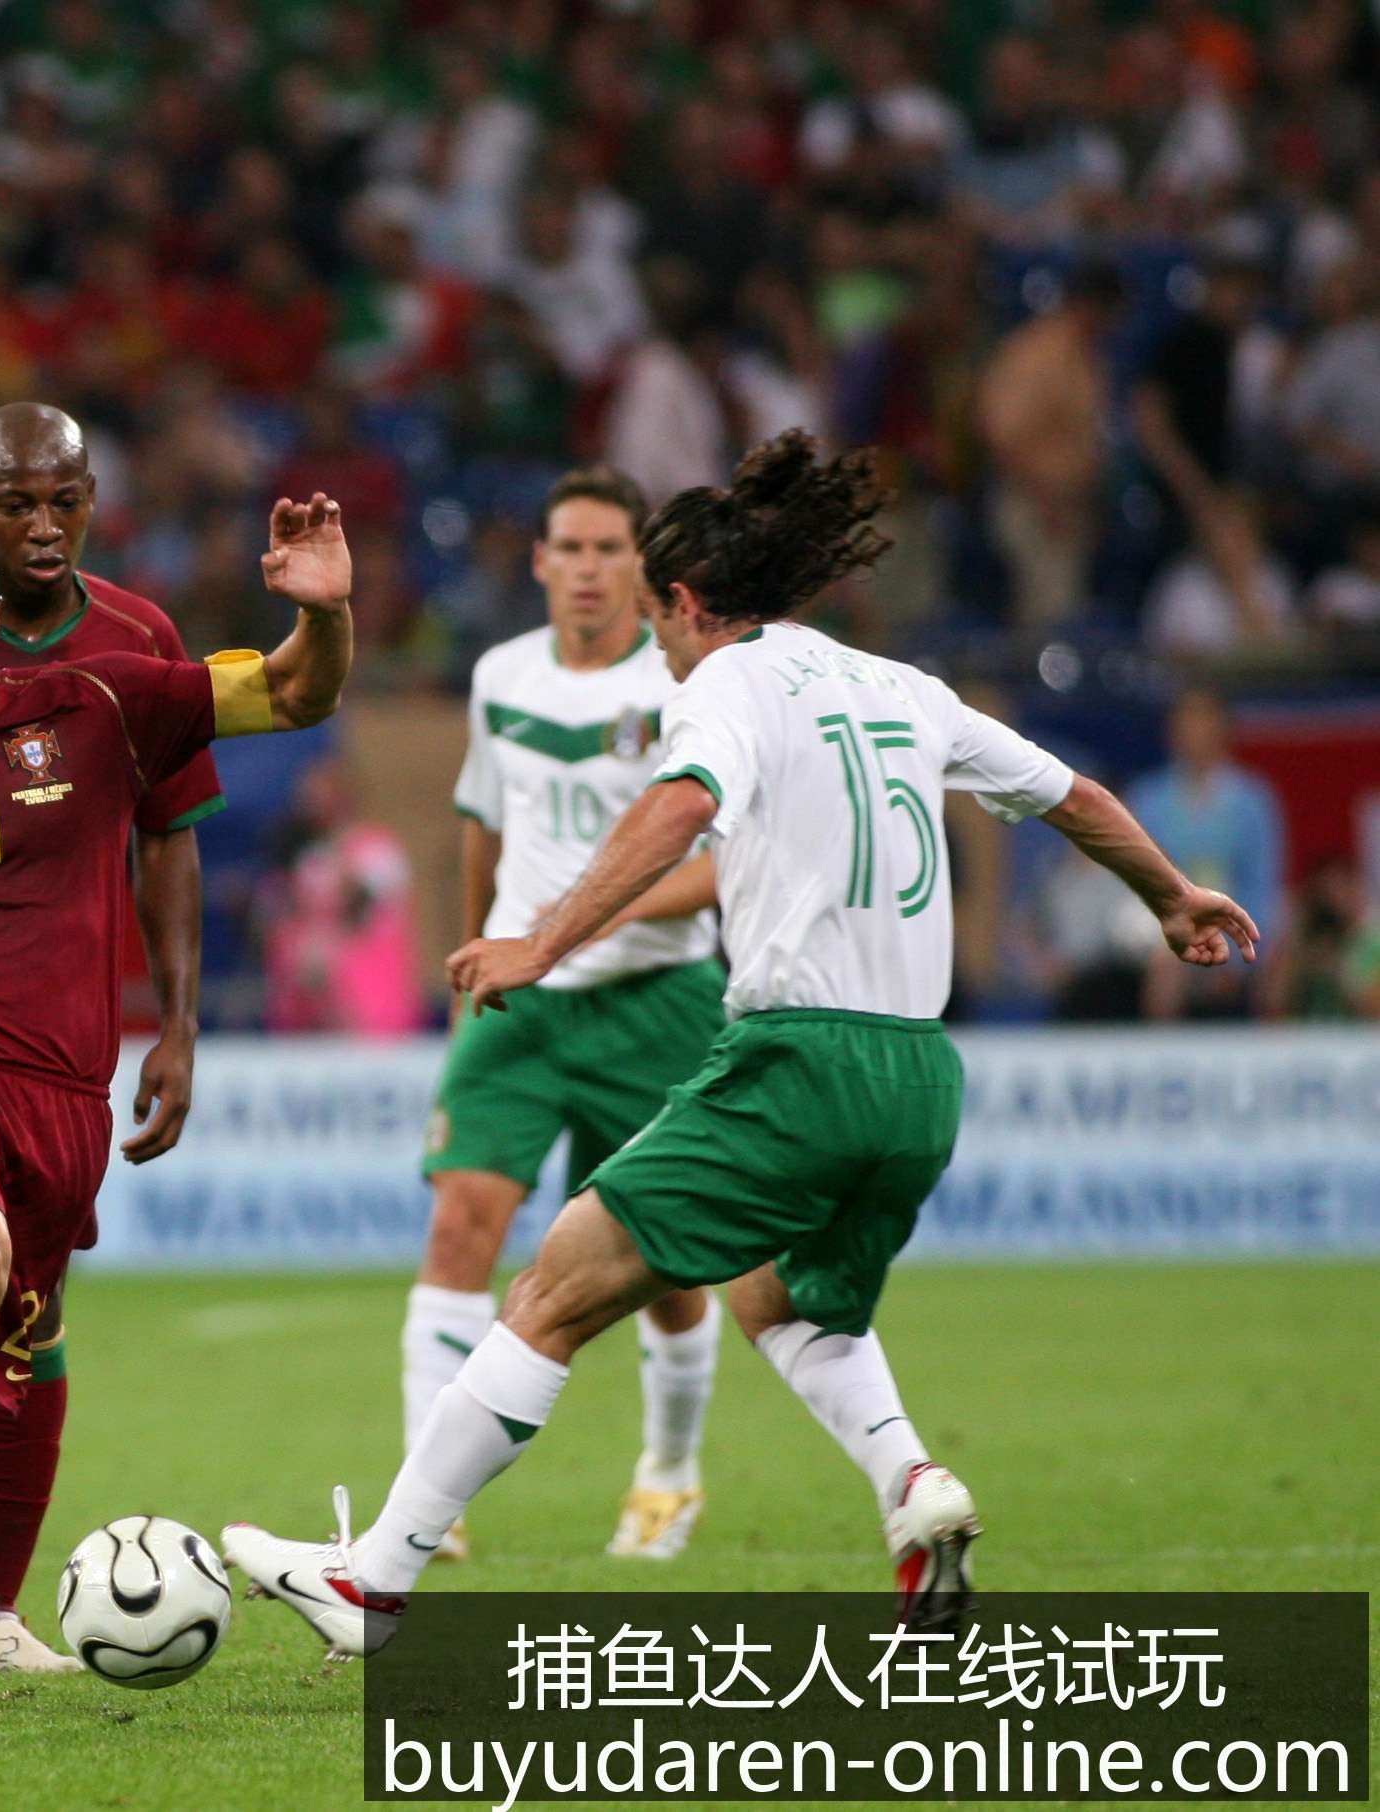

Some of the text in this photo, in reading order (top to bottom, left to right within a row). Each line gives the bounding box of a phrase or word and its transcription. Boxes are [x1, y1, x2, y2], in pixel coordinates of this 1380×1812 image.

[547, 773, 606, 841] 10
[815, 712, 937, 920] 15
[0, 1289, 47, 1361] 2
